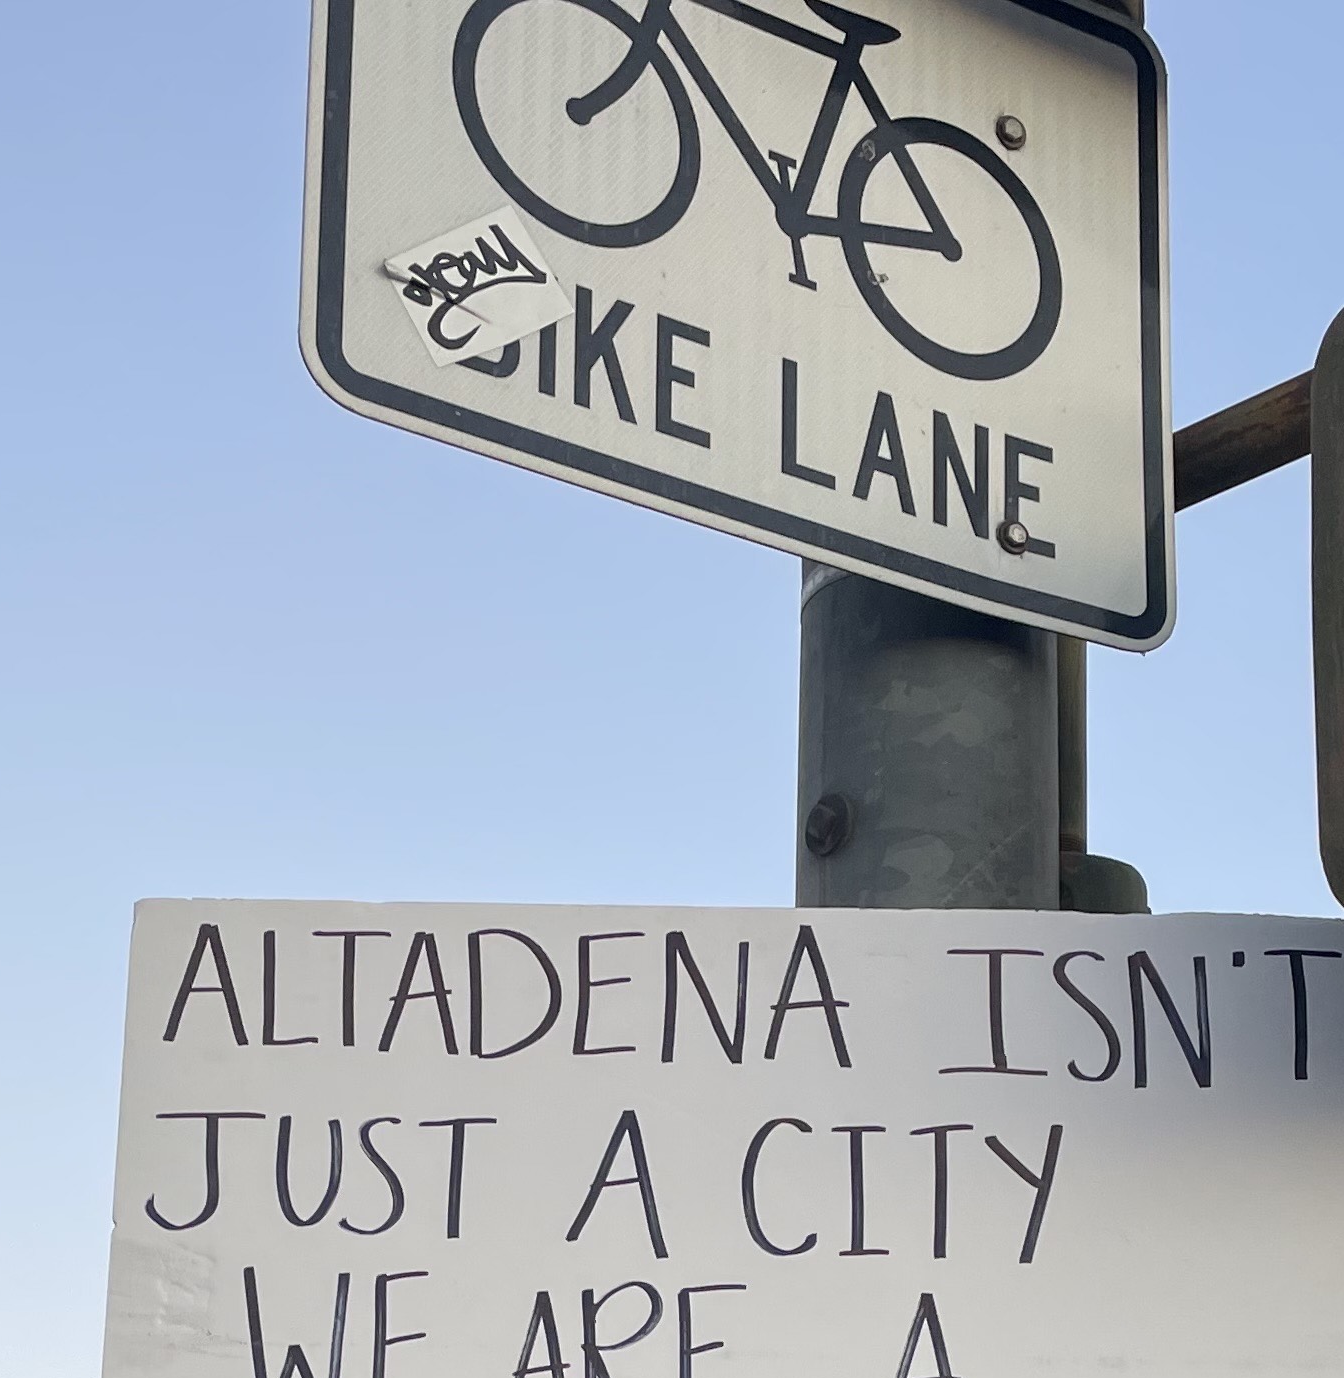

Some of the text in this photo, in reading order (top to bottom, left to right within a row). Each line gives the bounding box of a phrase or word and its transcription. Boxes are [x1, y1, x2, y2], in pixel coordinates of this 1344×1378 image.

[455, 284, 711, 449] IKE
[781, 358, 1056, 560] LANE
[163, 924, 1342, 1089] ALTADENA ISN'T
[145, 1110, 1063, 1265] JUST A CITY
